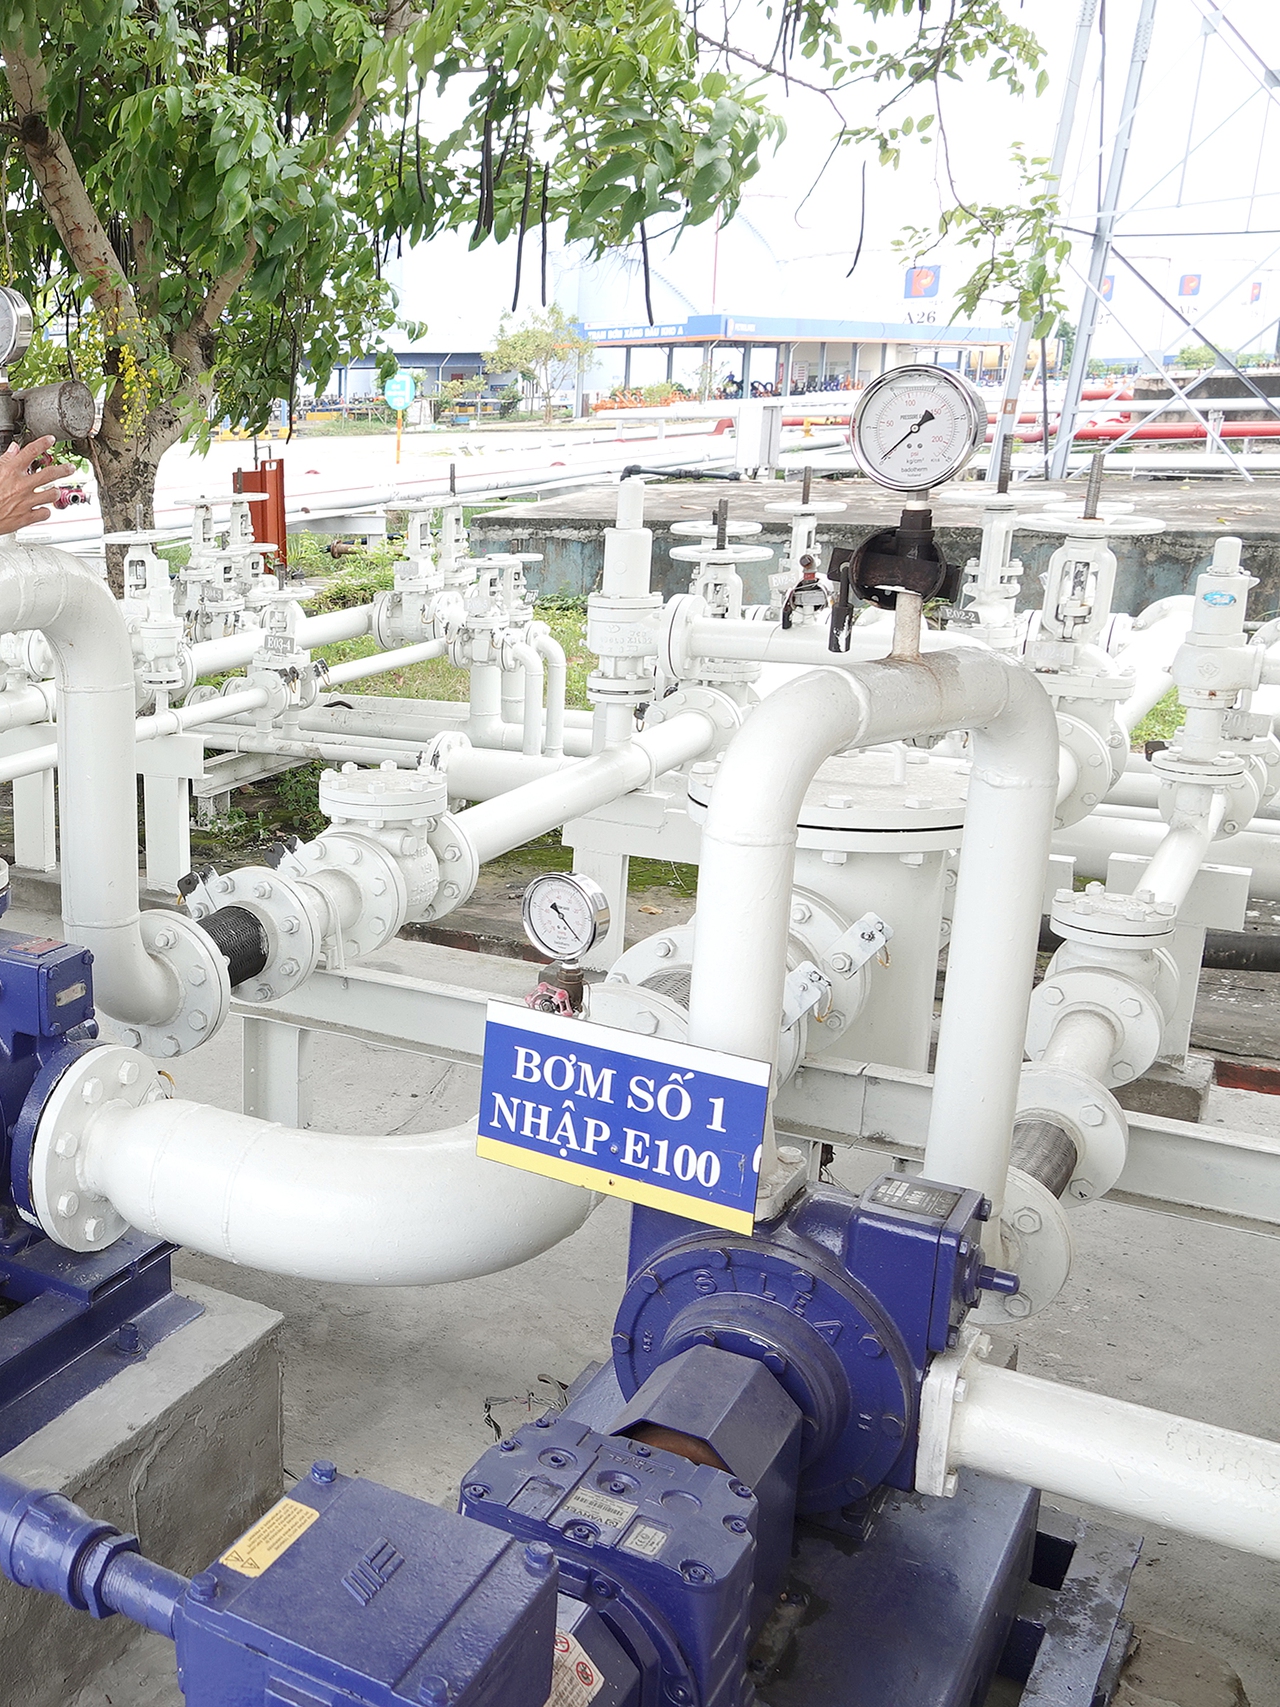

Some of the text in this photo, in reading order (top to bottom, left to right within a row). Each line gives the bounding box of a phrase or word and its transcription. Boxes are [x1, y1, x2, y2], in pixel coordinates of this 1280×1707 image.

[902, 310, 936, 325] A26
[905, 399, 917, 407] 100
[945, 608, 976, 621] E02-2
[267, 637, 291, 651] E03-4
[1031, 644, 1068, 660] E02-4
[512, 1045, 728, 1134] BƠM SỐ 1
[489, 1091, 612, 1158] NHẬP
[619, 1126, 722, 1188] E100
